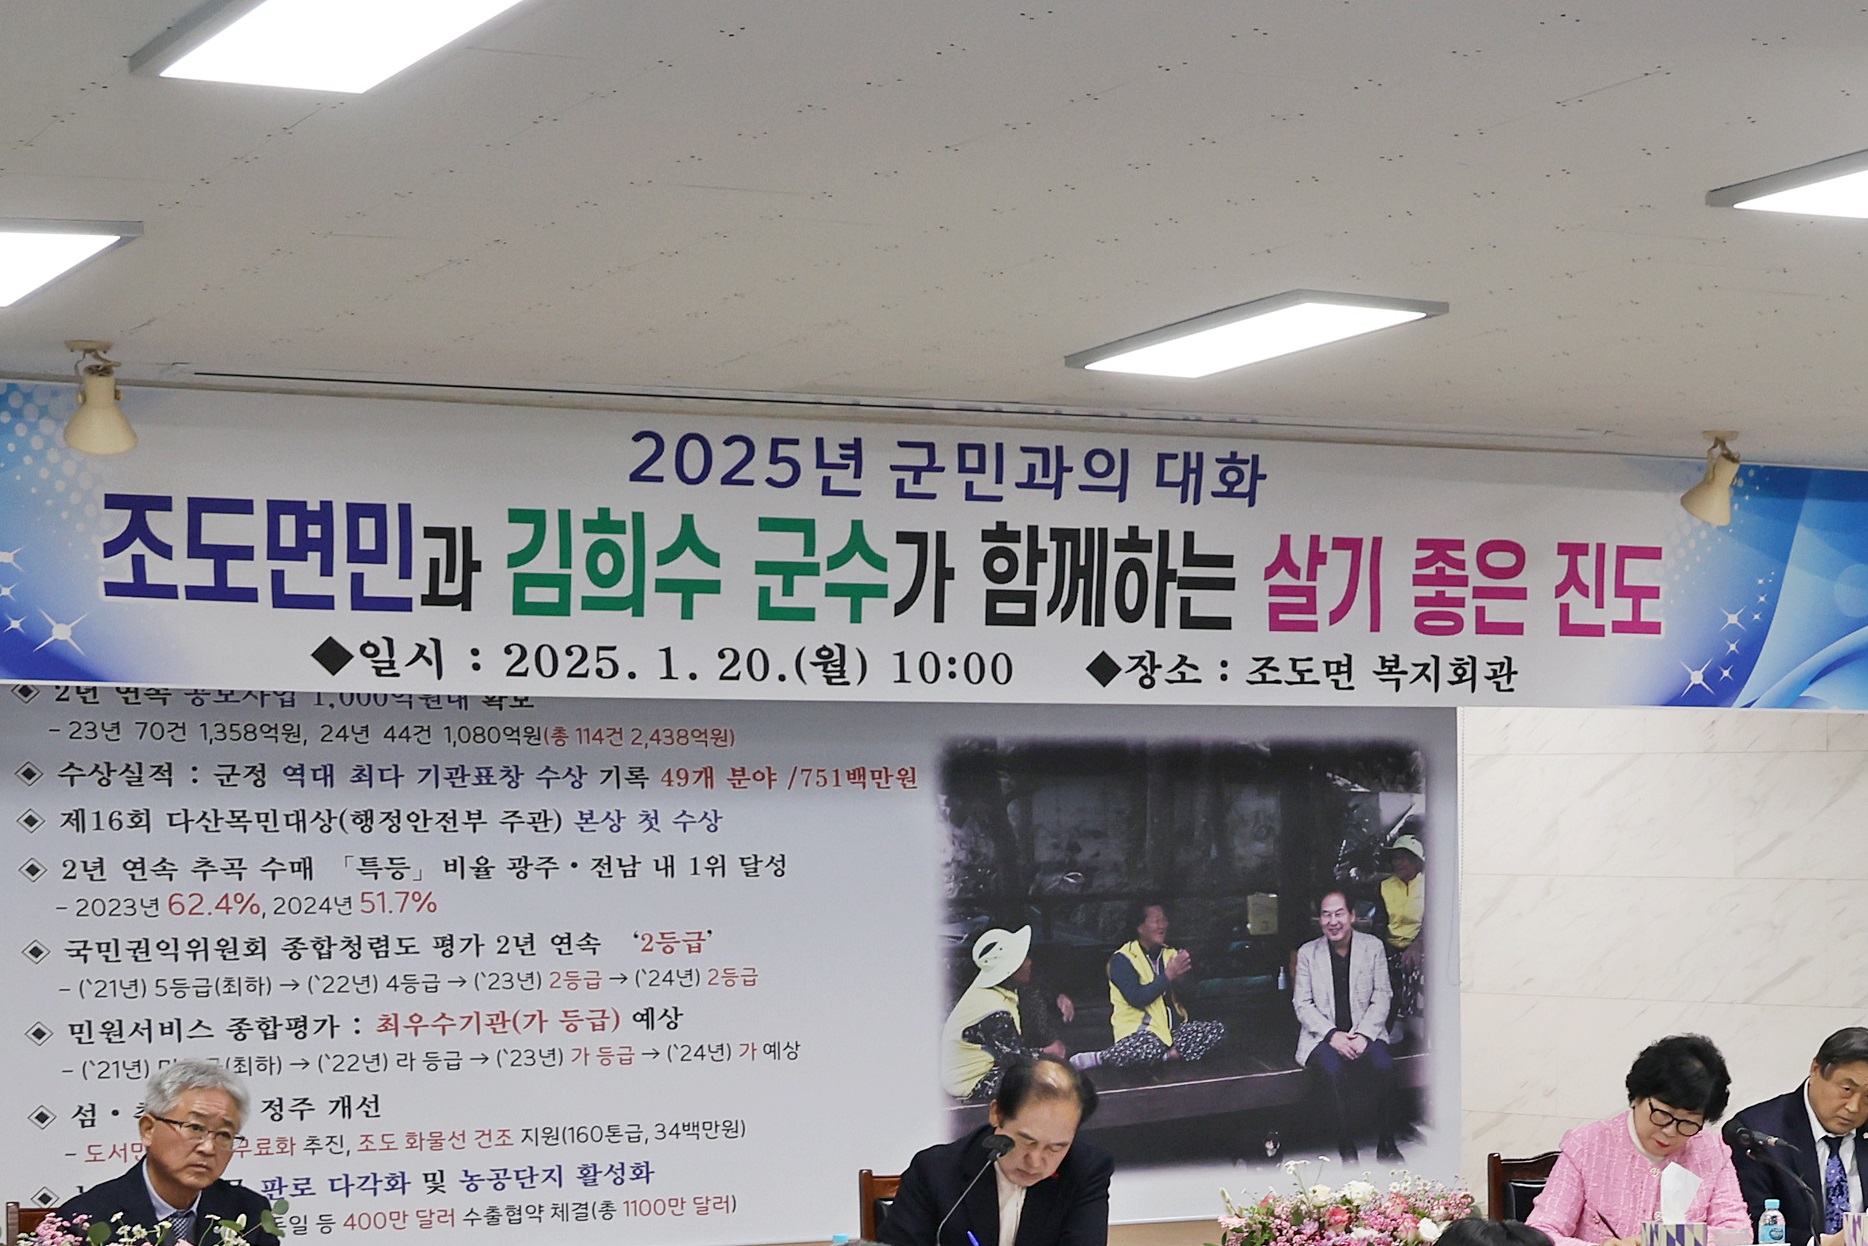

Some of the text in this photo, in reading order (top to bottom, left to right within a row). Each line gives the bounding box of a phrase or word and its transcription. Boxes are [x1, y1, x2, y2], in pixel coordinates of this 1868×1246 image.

[629, 431, 1267, 507] 2025년 군민과의 대화
[103, 493, 1662, 637] 조도면민과 김희수 군수가 함께하는 살기 좋은 진도
[504, 643, 636, 679] 2025.
[659, 647, 697, 680] 1.
[718, 643, 867, 686] 20.(월)
[893, 651, 1012, 685] 10:00
[1246, 653, 1354, 690] 조도면
[1373, 654, 1518, 693] 복지회관
[69, 721, 120, 741] 23년
[135, 722, 185, 742] 70건
[321, 725, 368, 744] 24년
[384, 725, 430, 744] 44건
[576, 727, 622, 746] 114건
[631, 728, 734, 749] 2,438억원)
[58, 762, 917, 790] 수상실적 군정 역대 최다 기관표창 수상 기록 49개 분야 /751백만원
[60, 808, 723, 833] 제16회 다산목민대상(행정안전부 주관) 본상 첫 수상
[63, 857, 106, 881] 2년
[123, 857, 178, 881] 연속
[191, 858, 247, 882] 추곡
[261, 856, 312, 881] 수매
[443, 856, 495, 880] 비율
[654, 855, 674, 878] 내
[691, 854, 725, 878] 1위
[739, 854, 785, 877] 달성
[76, 898, 158, 917] 2023년
[274, 896, 351, 915] 2024년
[361, 891, 436, 913] 51.7%
[65, 936, 266, 964] 국민권익위원회
[282, 935, 420, 960] 종합청렴도
[433, 934, 485, 958] 평가
[497, 933, 536, 956] 2년
[551, 932, 601, 955] 연속
[156, 977, 271, 998] 5등급(최하)
[386, 974, 440, 994] 4등급
[550, 971, 602, 990] 2등급
[708, 968, 758, 987] 2등급
[69, 1018, 214, 1044] 민원서비스
[227, 1015, 340, 1041] 종합평가
[559, 1008, 619, 1032] 등급)
[633, 1007, 683, 1030] 예상
[397, 1052, 416, 1071] 라
[423, 1051, 462, 1071] 등급
[572, 1047, 589, 1066] 가
[597, 1046, 635, 1066] 등급
[740, 1042, 757, 1061] 가
[763, 1041, 800, 1060] 예상
[72, 1094, 380, 1128] 섬 정주 개선
[303, 1135, 350, 1156] 추진,
[357, 1134, 398, 1151] 조도
[406, 1130, 465, 1151] 화물선
[475, 1129, 514, 1148] 건조
[655, 1120, 745, 1140] 34백만원)
[260, 1161, 654, 1199] 판로 다각화 및 농공단지 활성화
[316, 1214, 335, 1234] 등
[343, 1211, 409, 1230] 400만
[416, 1208, 454, 1229] 달러
[463, 1204, 544, 1226] 수출협약
[623, 1197, 686, 1216] 1100만
[693, 1195, 736, 1215] 달러)
